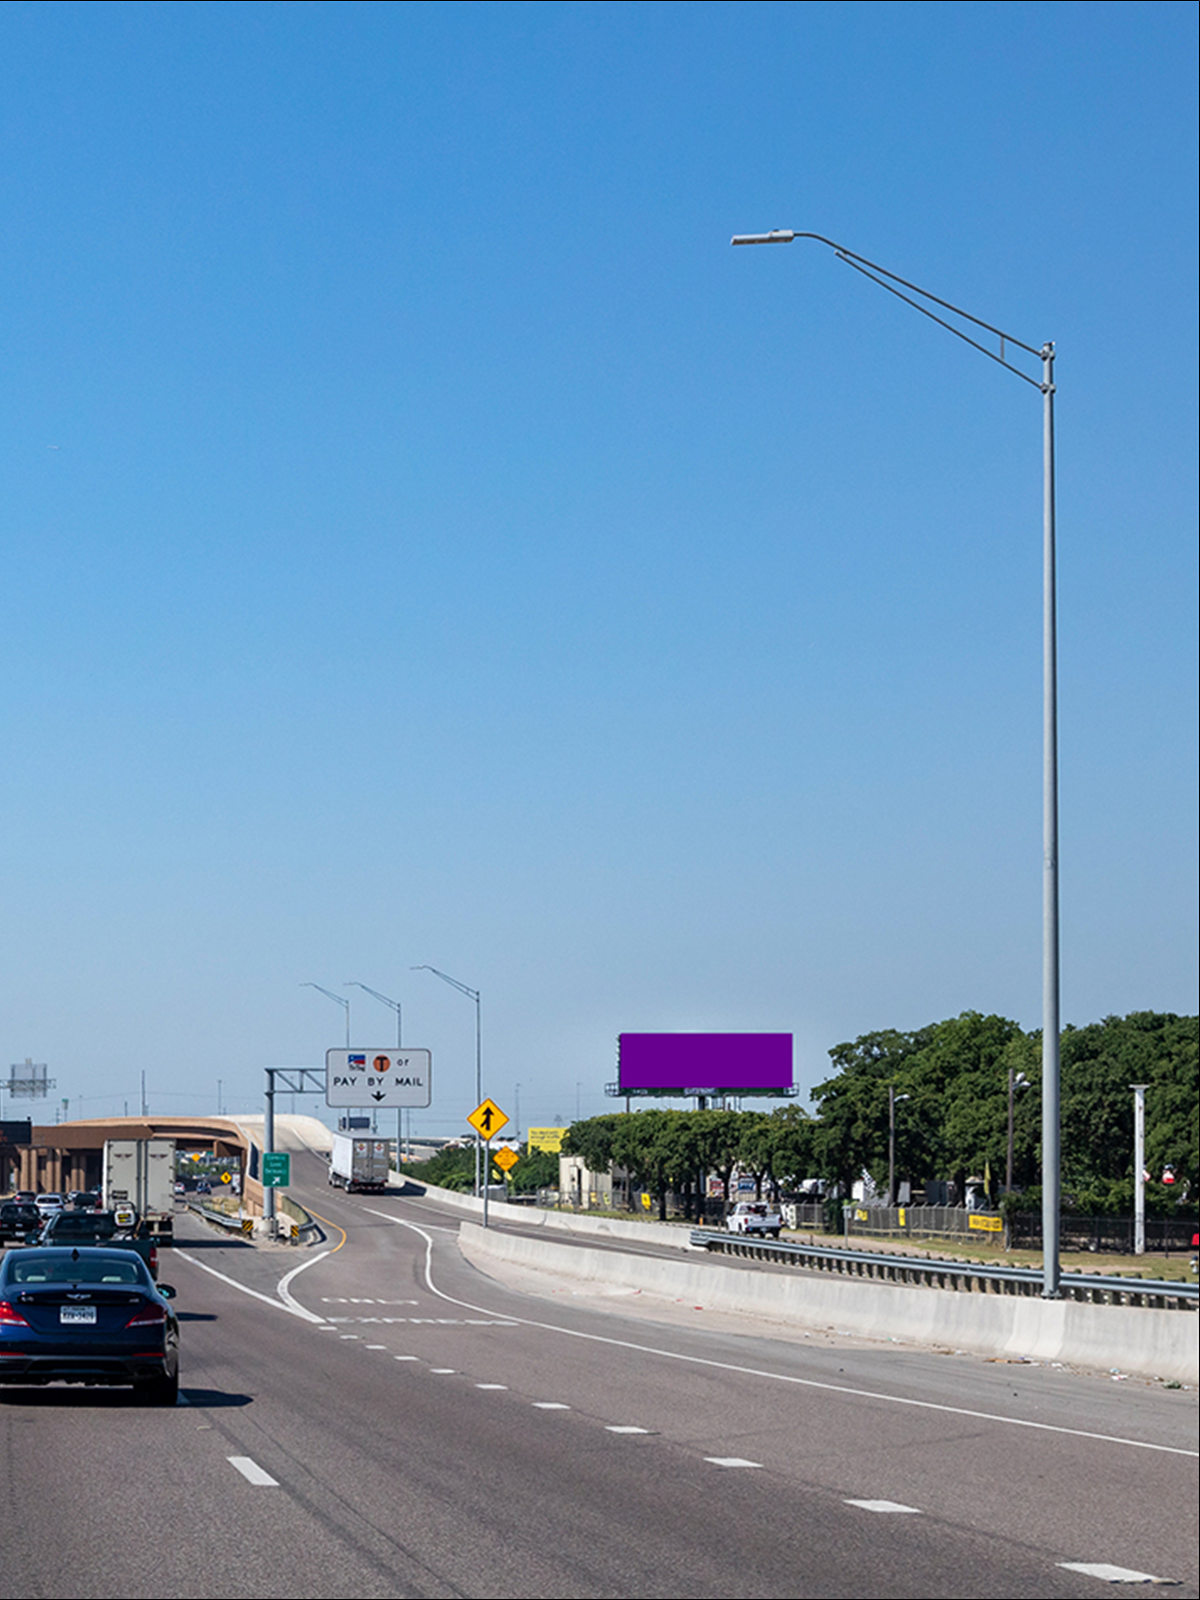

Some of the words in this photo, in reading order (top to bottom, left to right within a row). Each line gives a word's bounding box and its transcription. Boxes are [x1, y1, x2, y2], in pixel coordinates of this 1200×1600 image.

[397, 1058, 409, 1067] or
[333, 1077, 357, 1087] PAY
[367, 1077, 384, 1087] BY
[395, 1077, 424, 1087] MAIL
